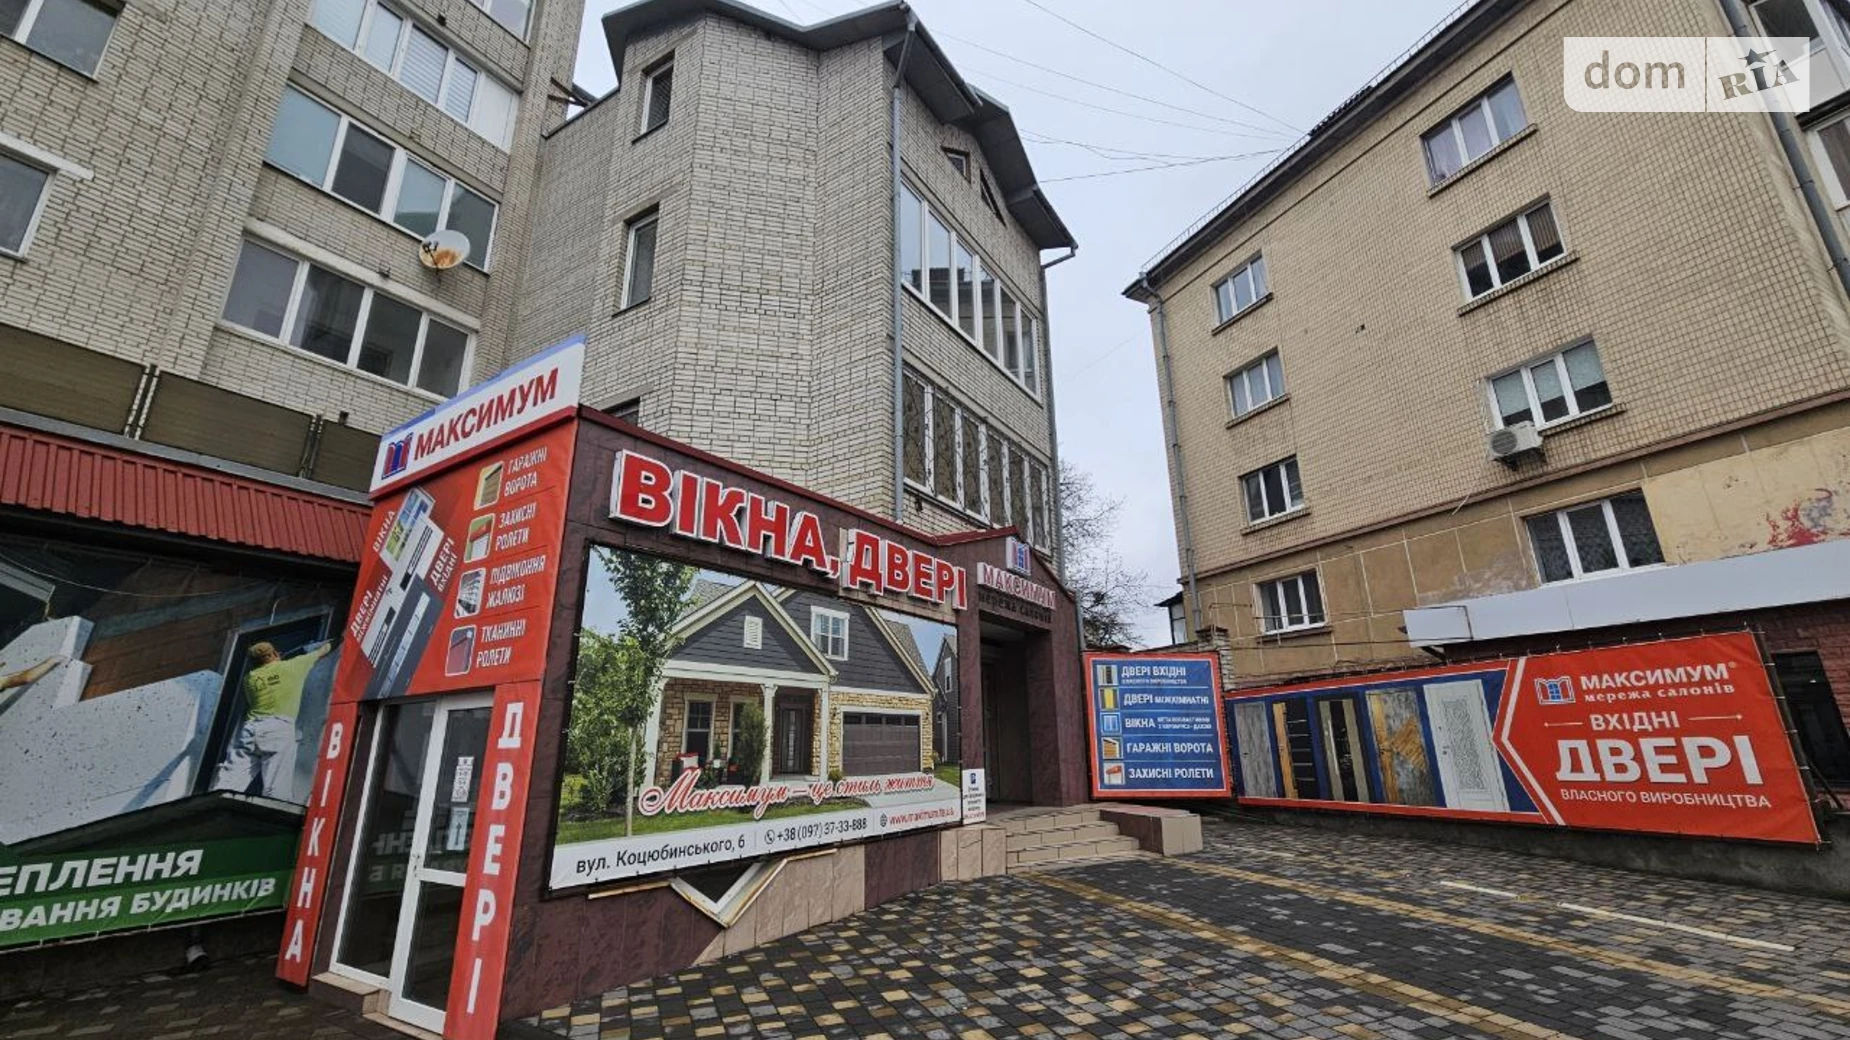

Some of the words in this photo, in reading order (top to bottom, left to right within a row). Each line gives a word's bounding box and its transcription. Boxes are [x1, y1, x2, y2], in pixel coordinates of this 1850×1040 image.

[413, 367, 559, 461] МАКСИМУМ
[507, 446, 547, 475] ГАРАЖНІ
[504, 471, 537, 497] ВОРОТА
[499, 502, 536, 528] ЗАХИСНІ
[372, 511, 395, 552] ВІКНА
[495, 527, 529, 551] РОЛЕТИ
[616, 449, 840, 579] ВІКНА,
[848, 528, 967, 610] ДВЕРІ
[429, 537, 454, 586] ДВЕРІ
[350, 590, 372, 637] ДВЕРІ
[482, 619, 526, 643] ТКАНИННІ
[476, 647, 511, 668] РОЛЕТИ
[1121, 666, 1150, 678] ДВЕРІ
[1152, 666, 1186, 678] ВХІДНІ
[1580, 663, 1730, 690] МАКСИМУМ
[1124, 694, 1153, 706] ДВЕРІ
[1584, 689, 1651, 703] мережа
[1657, 682, 1735, 697] салонів
[1125, 718, 1156, 728] ВІКНА
[1590, 711, 1680, 732] ВХІДНІ
[1127, 743, 1171, 753] ГАРАЖНІ
[1174, 743, 1213, 753] ВОРОТА
[1556, 735, 1763, 784] ДВЕРІ
[1129, 769, 1172, 778] ЗАХИСНІ
[1175, 768, 1214, 778] РОЛЕТИ
[638, 765, 789, 820] Максимум
[810, 780, 832, 805] це
[835, 776, 881, 795] стиль
[883, 774, 935, 792] життя
[1560, 788, 1636, 803] ВЛАСНОГО
[1640, 790, 1771, 808] ВИРОБНИЦТВА
[285, 724, 343, 963] ВІКНА
[576, 857, 611, 876] вул.
[616, 839, 735, 867] Коцюбинського,
[738, 836, 745, 849] 6
[467, 702, 524, 1014] ДВЕРІ
[130, 878, 276, 914] БУДИНКІВ
